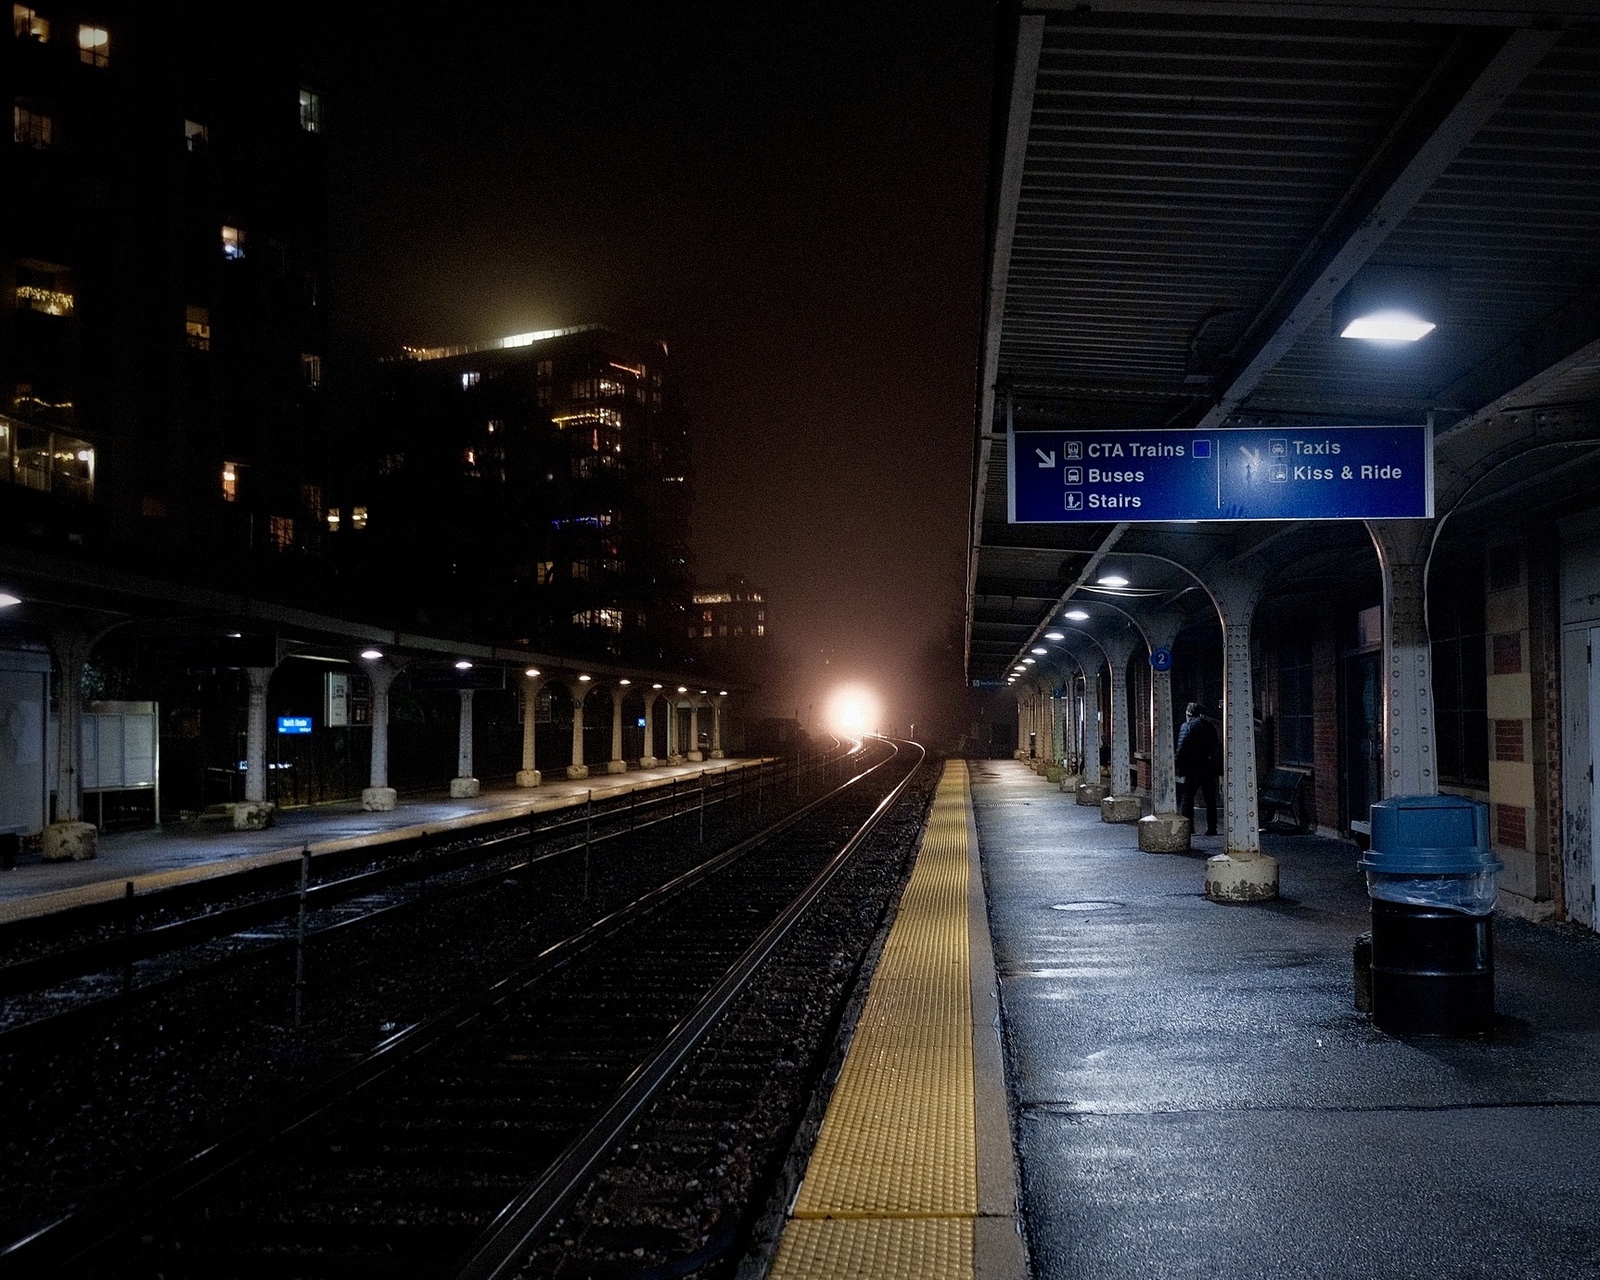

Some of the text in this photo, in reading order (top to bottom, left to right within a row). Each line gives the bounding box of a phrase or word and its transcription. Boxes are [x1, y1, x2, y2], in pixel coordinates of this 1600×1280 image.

[1088, 442, 1185, 458] CTA Trains
[1293, 440, 1341, 455] Taxis
[1088, 468, 1145, 483] Buses
[1294, 465, 1402, 480] Kiss & Ride
[1088, 493, 1142, 508] Stairs
[1157, 653, 1165, 664] 2
